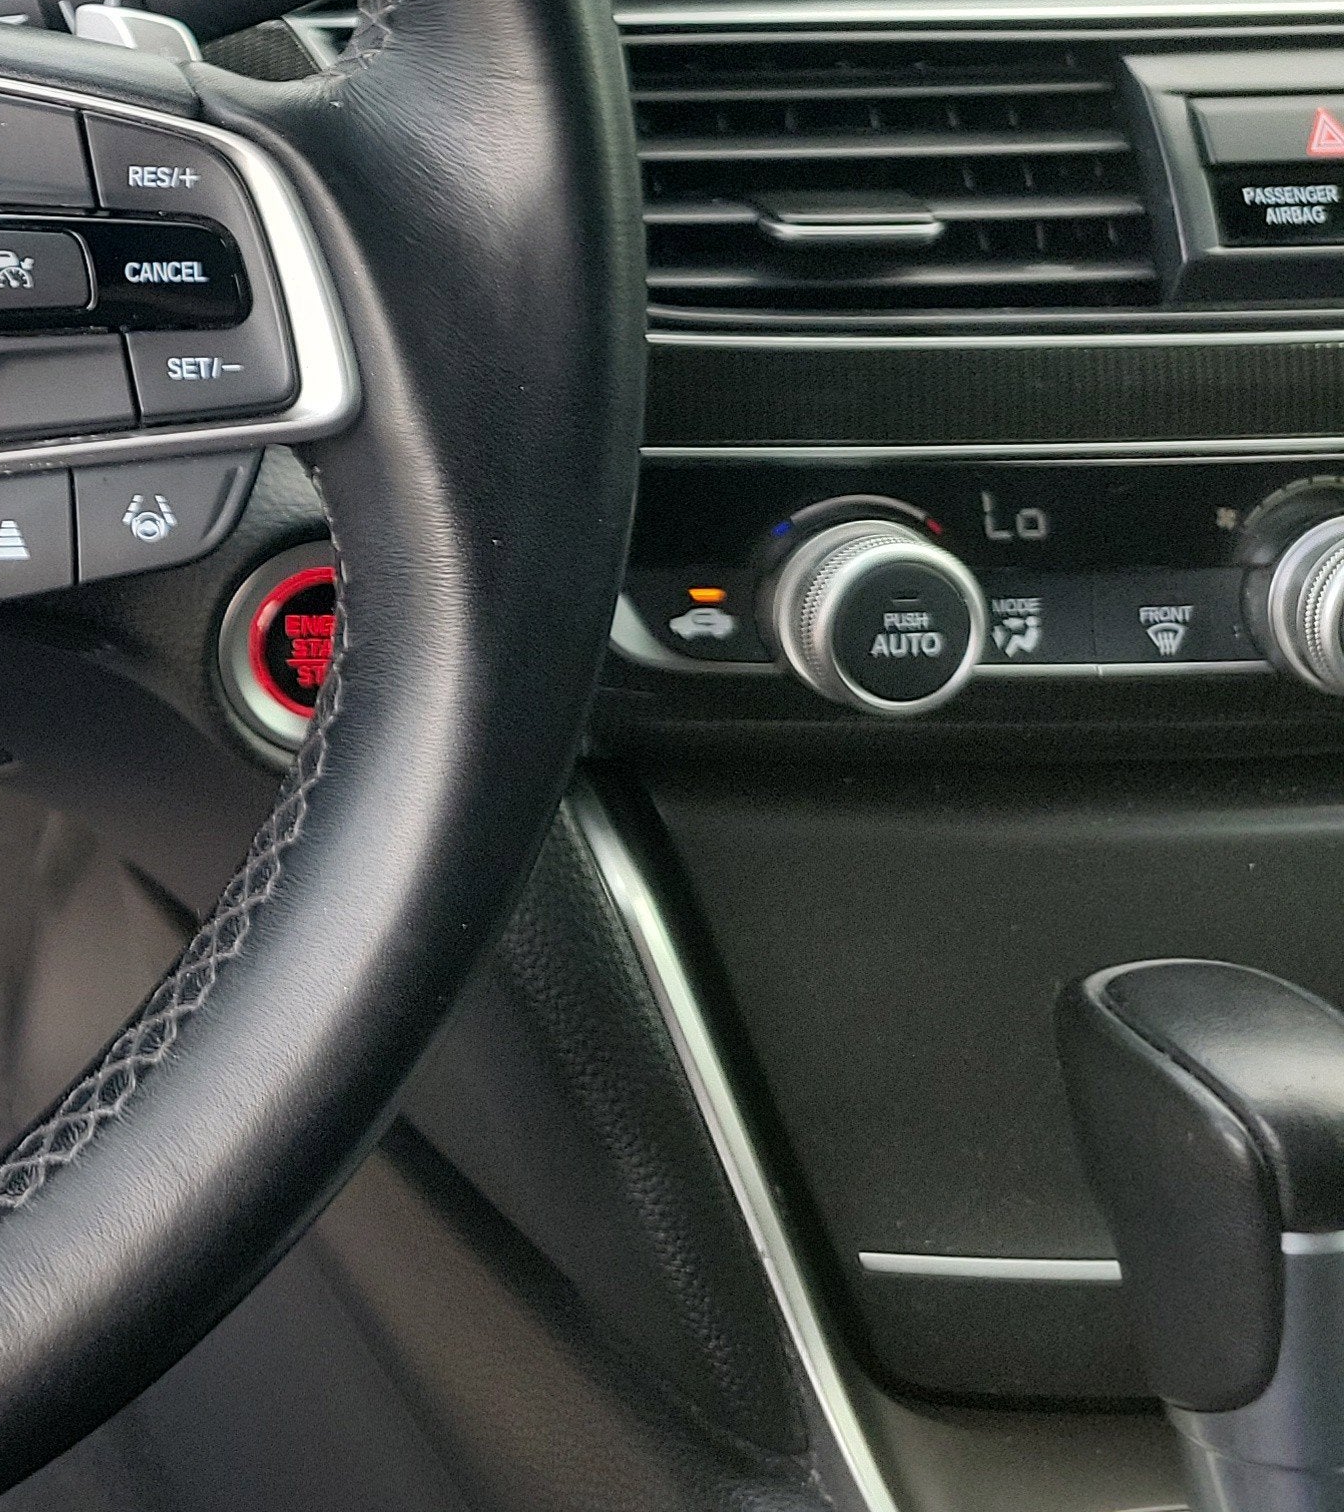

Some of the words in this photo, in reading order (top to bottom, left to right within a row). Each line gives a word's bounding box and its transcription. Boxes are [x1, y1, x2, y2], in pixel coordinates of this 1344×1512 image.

[128, 164, 200, 189] RES/+
[1241, 184, 1341, 206] PASSENGER
[1265, 205, 1328, 226] AIRBAG
[124, 261, 208, 284] CANCEL
[992, 598, 1043, 614] MODE
[1139, 605, 1195, 624] FRONT
[285, 615, 336, 637] ENG
[883, 611, 930, 631] PUSH
[870, 631, 944, 658] AUTO
[298, 666, 326, 688] ST
